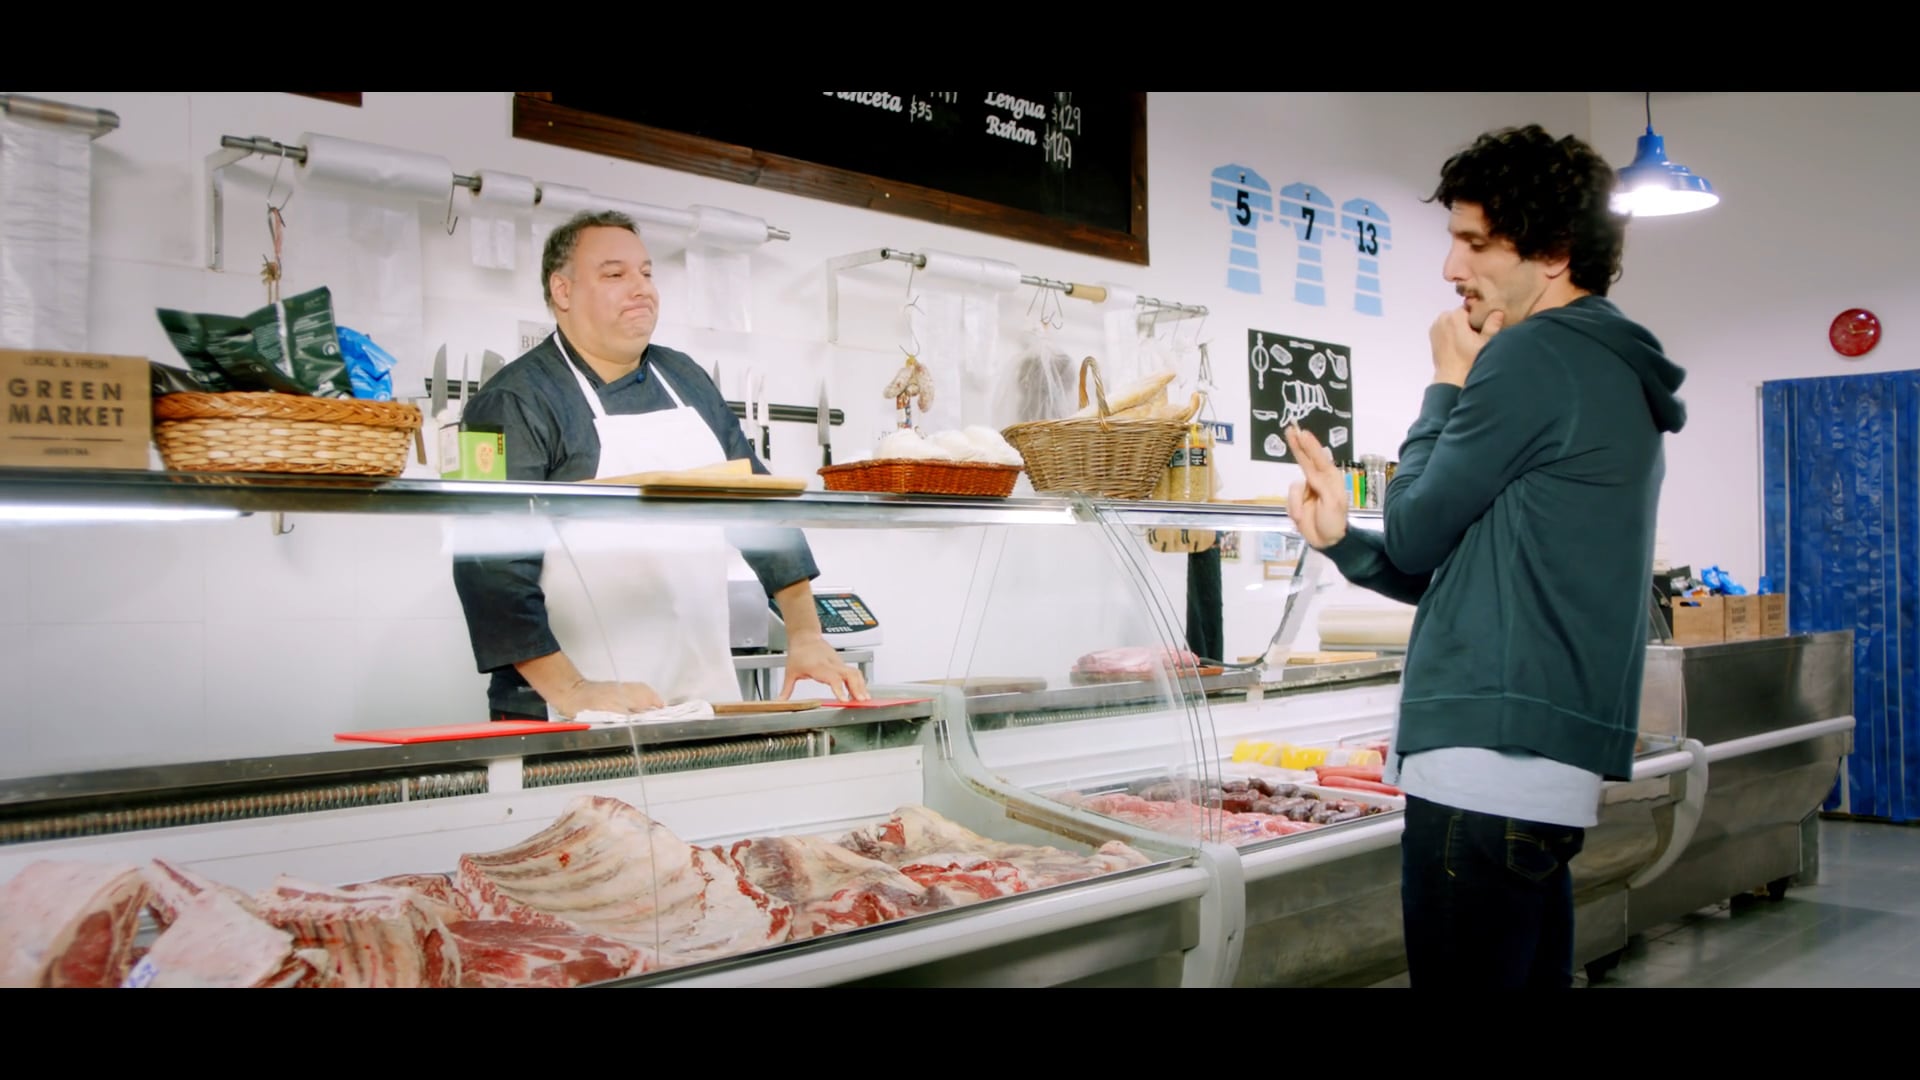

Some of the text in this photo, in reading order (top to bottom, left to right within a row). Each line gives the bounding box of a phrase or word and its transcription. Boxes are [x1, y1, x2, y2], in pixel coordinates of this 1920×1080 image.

[909, 94, 933, 123] $35
[984, 91, 1046, 120] Lengua
[1236, 189, 1251, 226] 5
[1302, 206, 1315, 240] 7
[1357, 220, 1379, 256] 13
[8, 378, 123, 401] GREEN
[8, 403, 125, 427] MARKET
